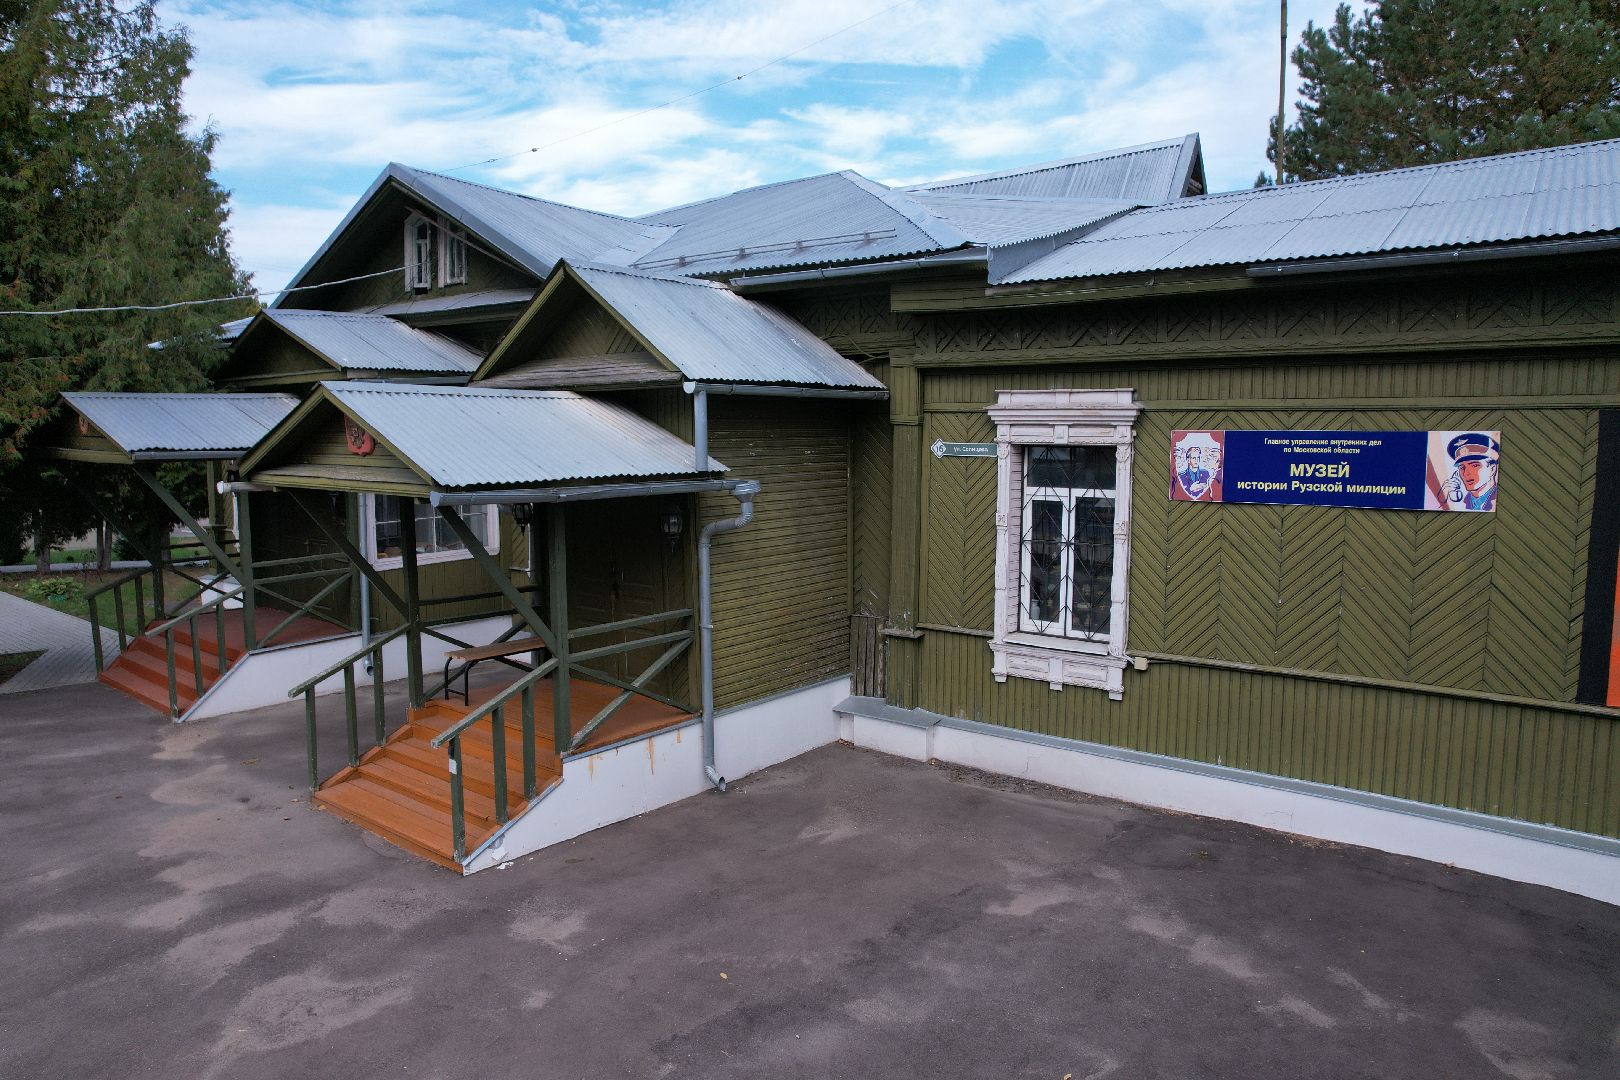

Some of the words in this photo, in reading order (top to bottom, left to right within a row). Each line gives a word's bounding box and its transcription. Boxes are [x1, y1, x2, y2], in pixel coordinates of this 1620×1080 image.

[1264, 438, 1290, 446] Главное
[1293, 446, 1332, 454] Московской
[1290, 461, 1350, 478] МУЗЕЙ
[1237, 481, 1288, 492] истории
[1291, 481, 1343, 494] Рузской
[1346, 485, 1406, 496] милиции
